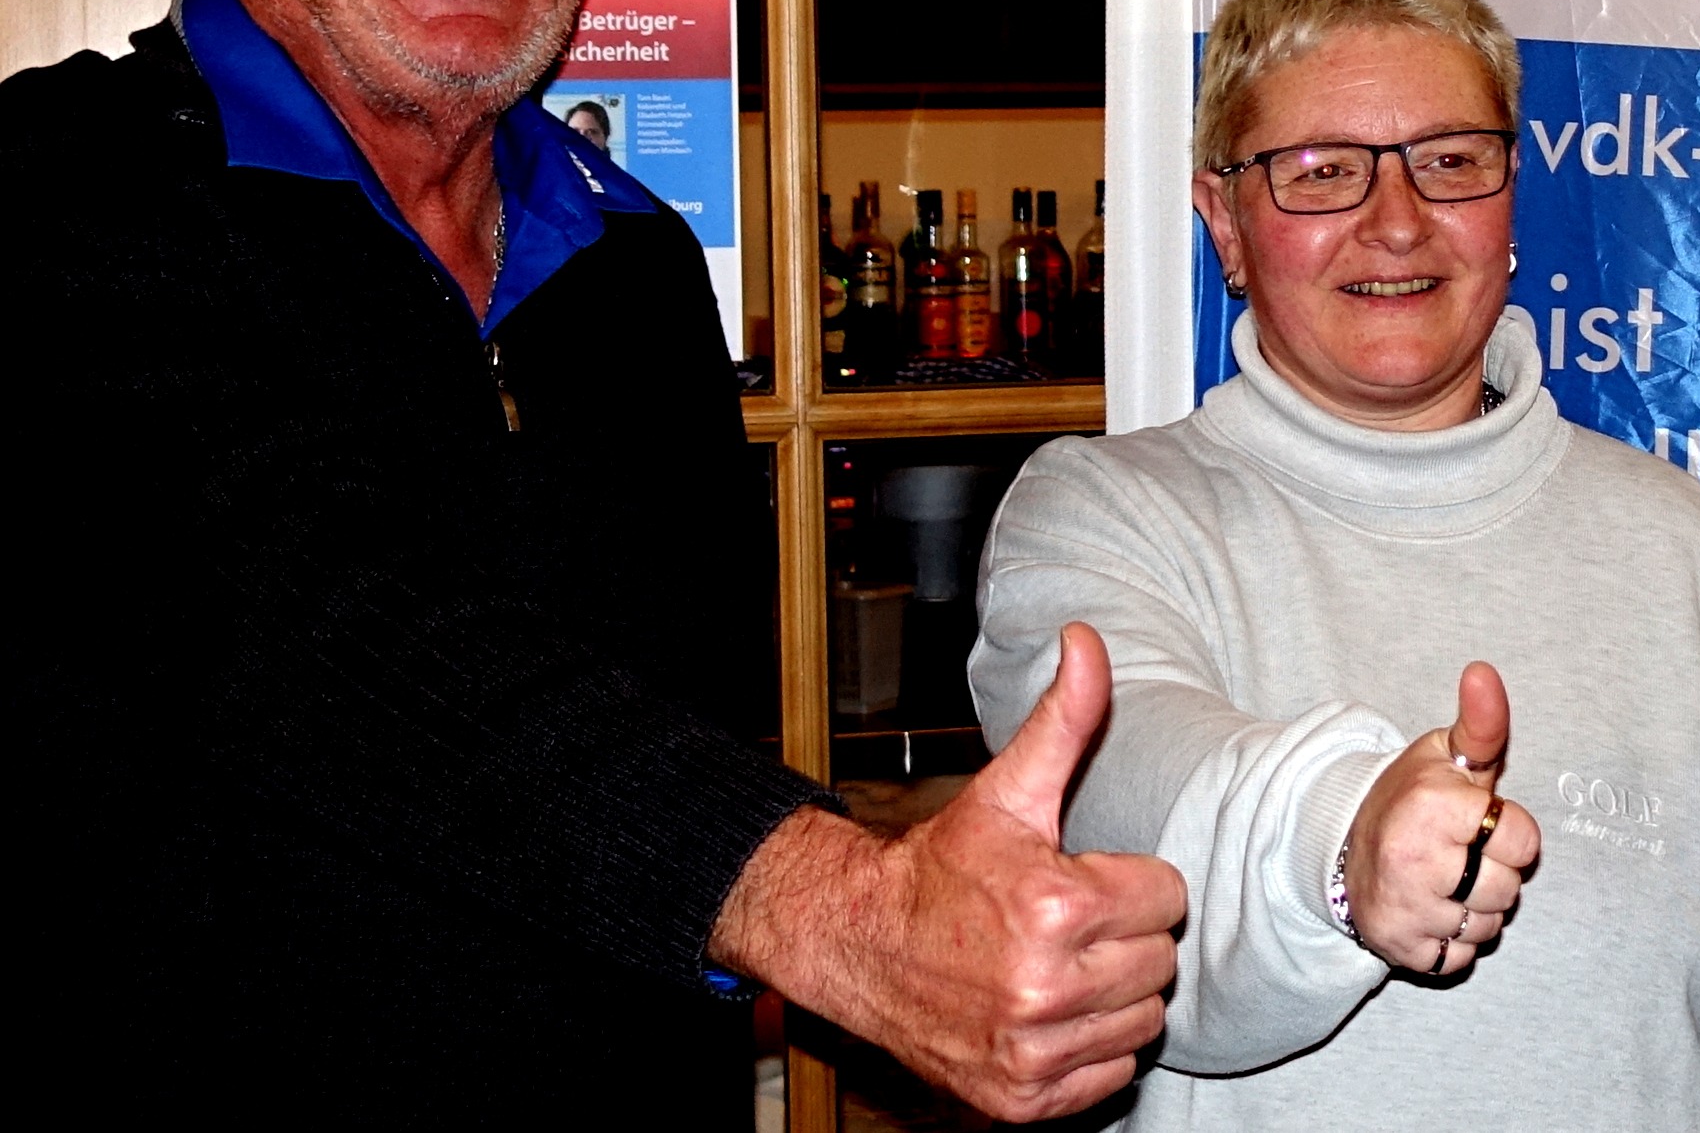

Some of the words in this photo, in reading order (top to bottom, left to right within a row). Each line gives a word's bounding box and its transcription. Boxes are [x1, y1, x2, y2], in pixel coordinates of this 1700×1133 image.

[579, 10, 678, 35] Betrüger
[564, 40, 670, 62] icherheit
[669, 199, 702, 214] burg
